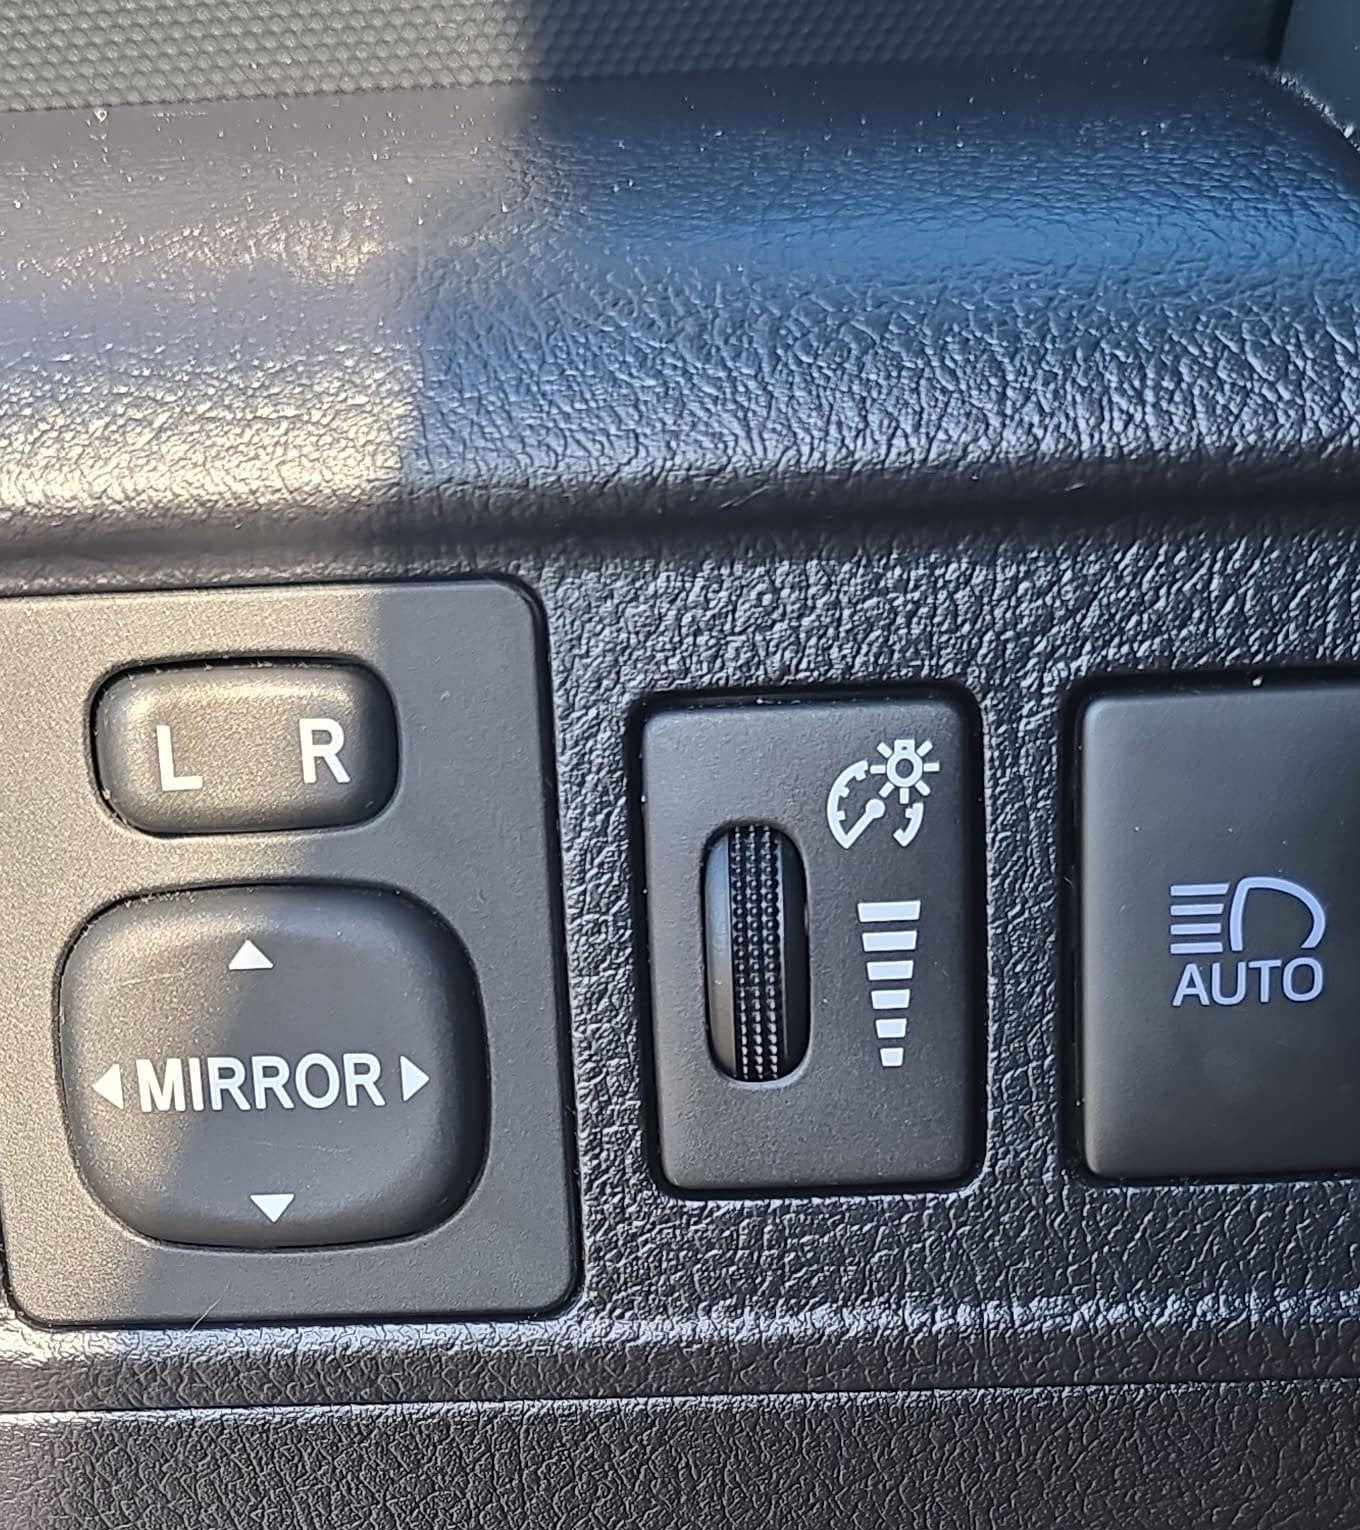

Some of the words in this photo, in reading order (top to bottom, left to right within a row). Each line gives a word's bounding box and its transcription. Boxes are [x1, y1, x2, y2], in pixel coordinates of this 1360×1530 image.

[156, 724, 202, 791] L
[298, 718, 350, 784] R
[1172, 956, 1324, 1007] AUTO
[138, 1053, 385, 1113] MIRROR
